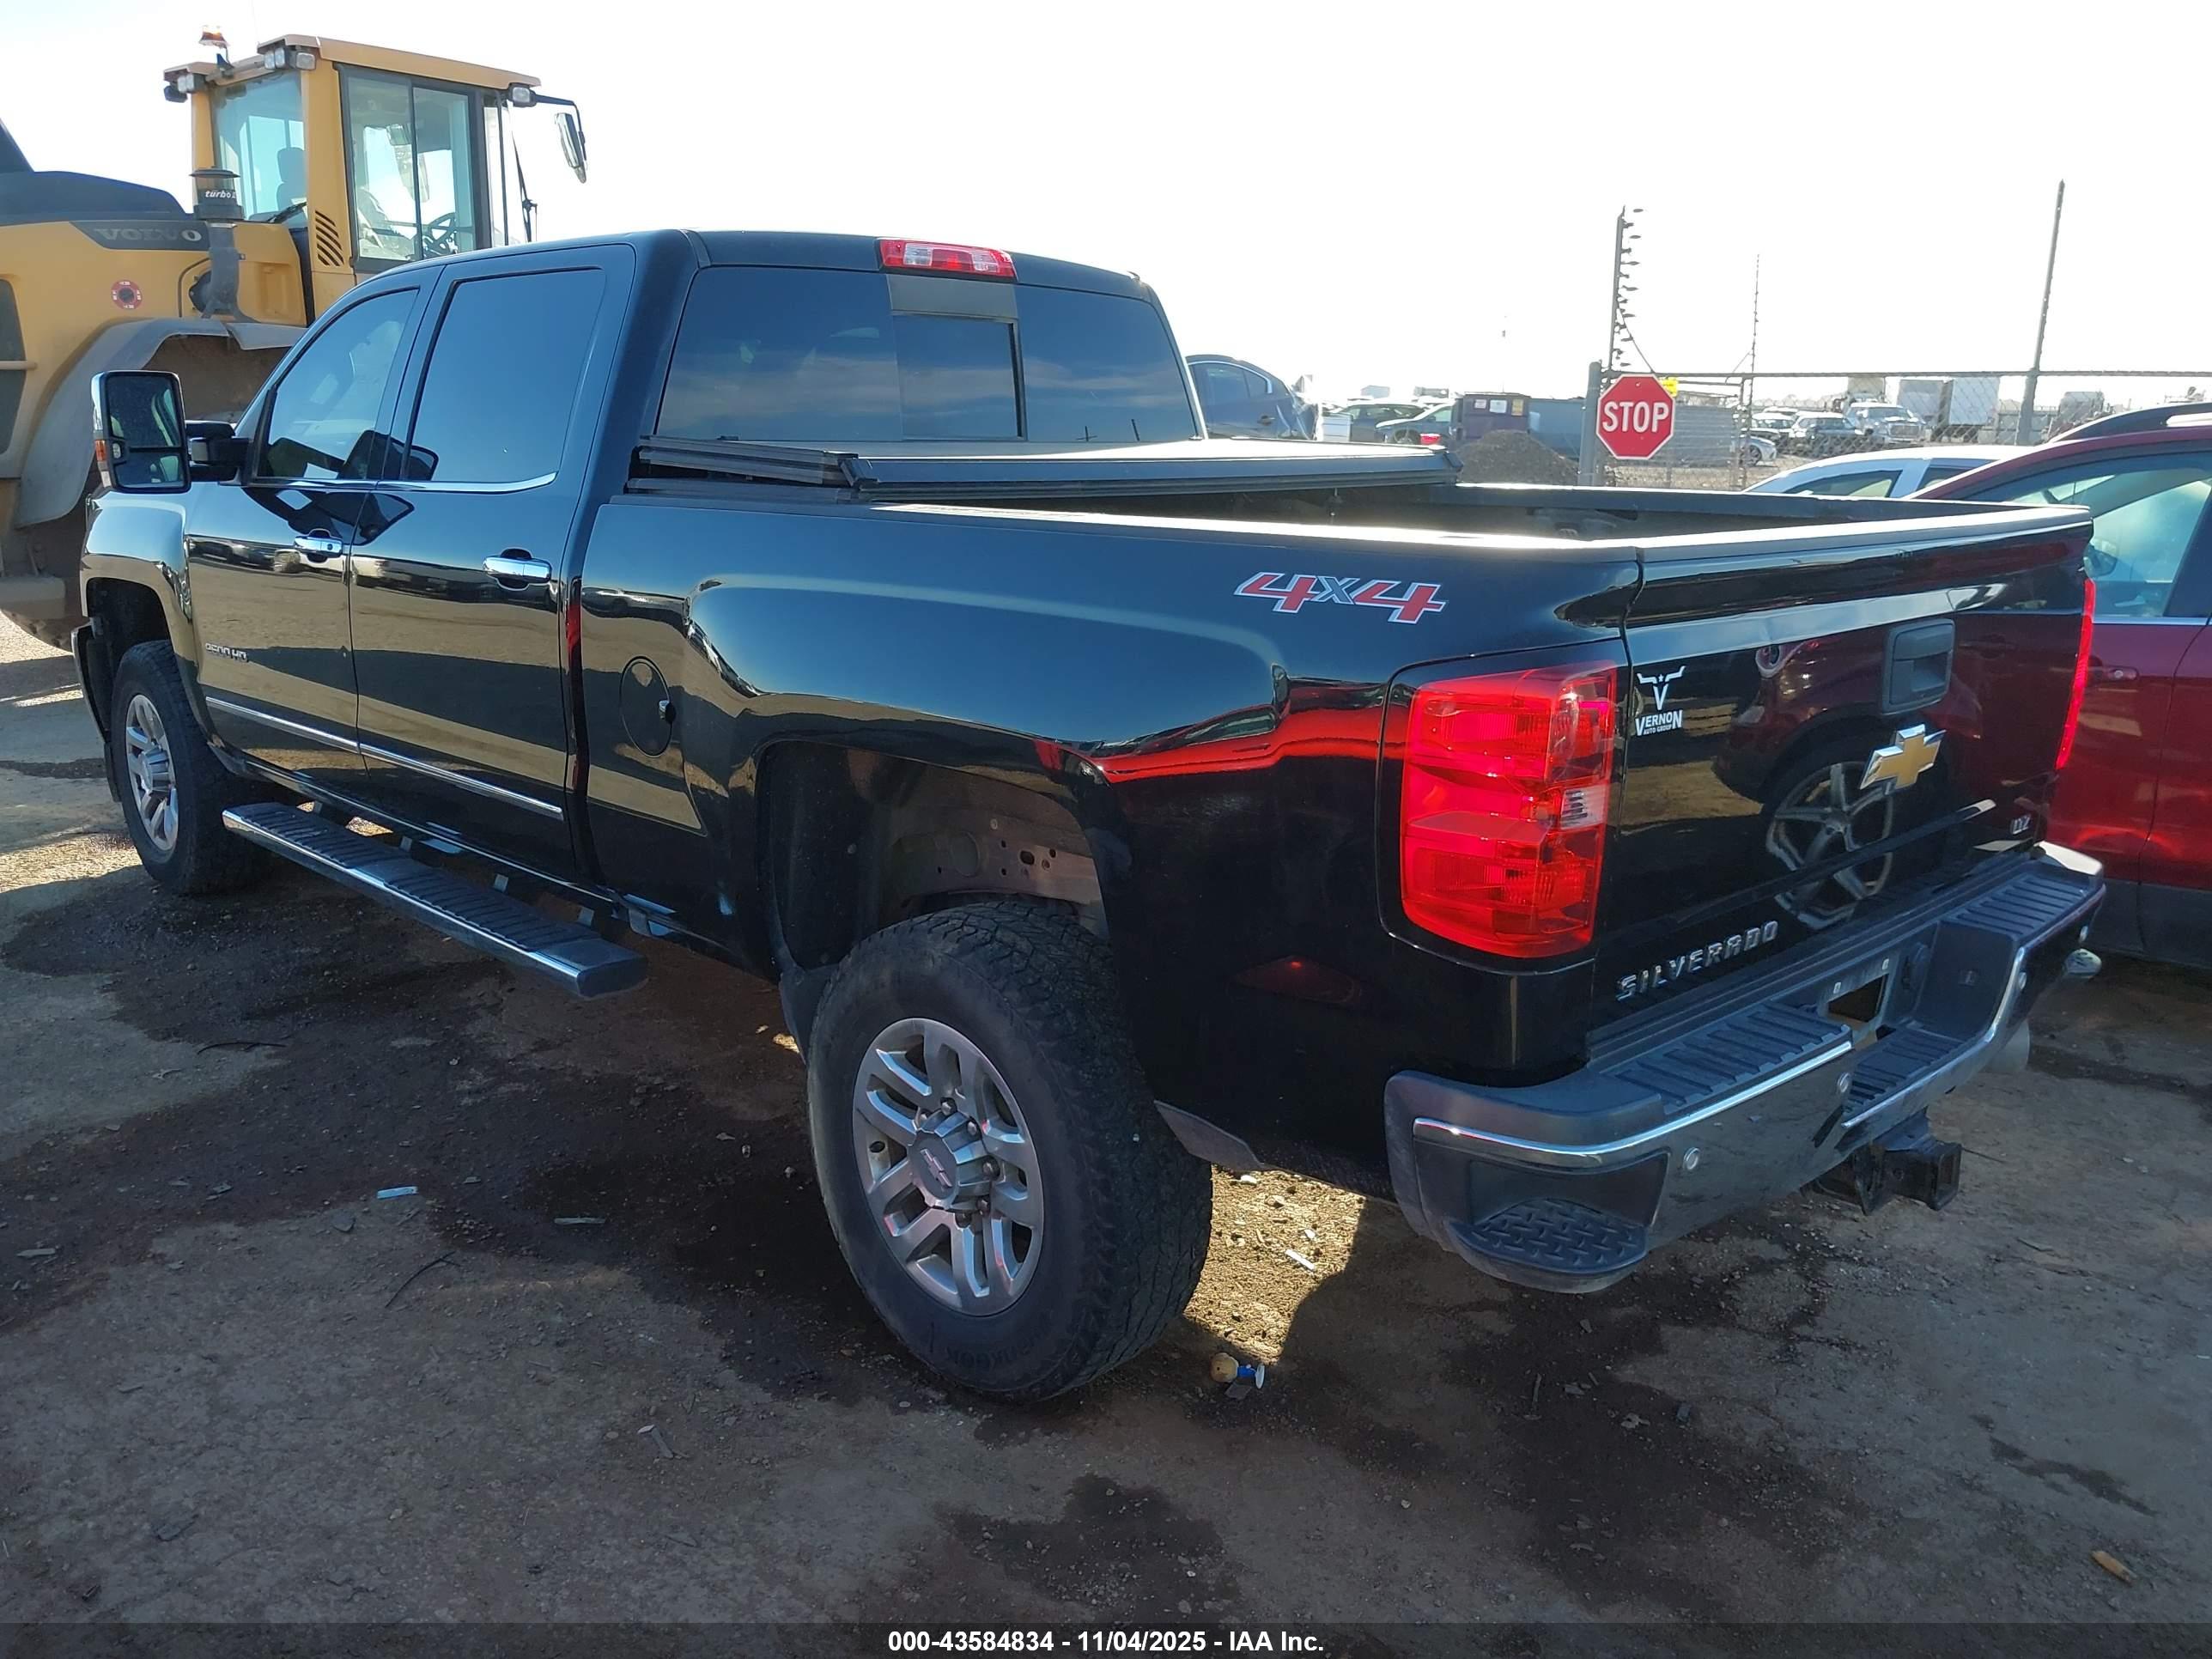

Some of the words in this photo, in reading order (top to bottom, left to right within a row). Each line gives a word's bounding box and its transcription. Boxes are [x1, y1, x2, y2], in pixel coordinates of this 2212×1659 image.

[205, 190, 231, 198] turbo
[94, 228, 203, 241] VOLVO
[1602, 401, 1669, 433] STOP
[1635, 709, 1683, 736] VERNON
[1644, 726, 1656, 735] AUTO
[1615, 920, 1779, 1001] SILVERADO
